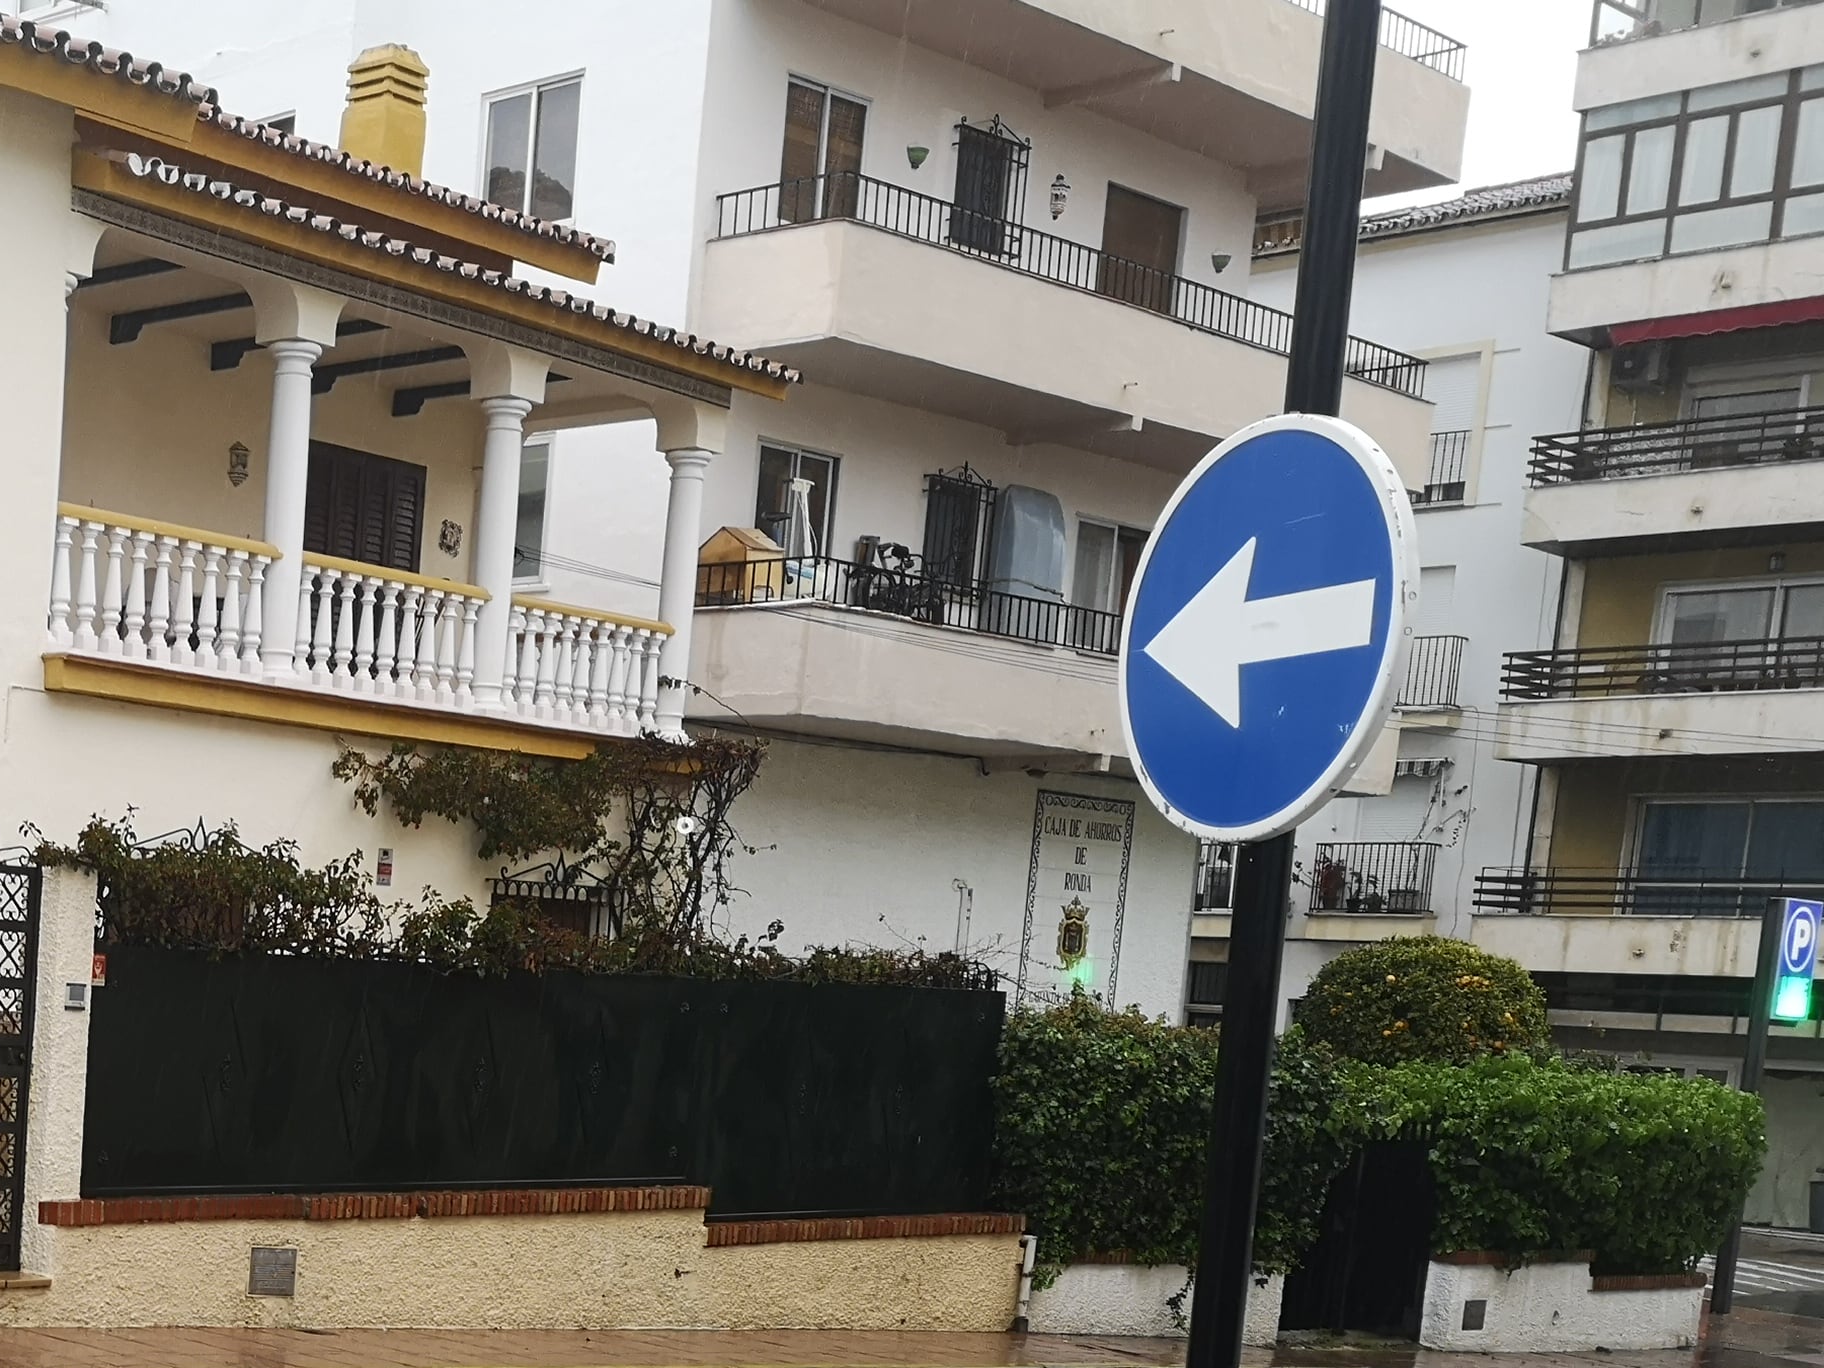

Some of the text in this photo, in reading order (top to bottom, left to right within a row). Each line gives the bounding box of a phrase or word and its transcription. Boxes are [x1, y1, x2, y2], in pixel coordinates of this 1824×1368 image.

[1044, 816, 1123, 842] CAJA DE AHORROS
[1075, 846, 1088, 865] DE
[1064, 872, 1091, 893] RONDA
[1790, 918, 1811, 961] P
